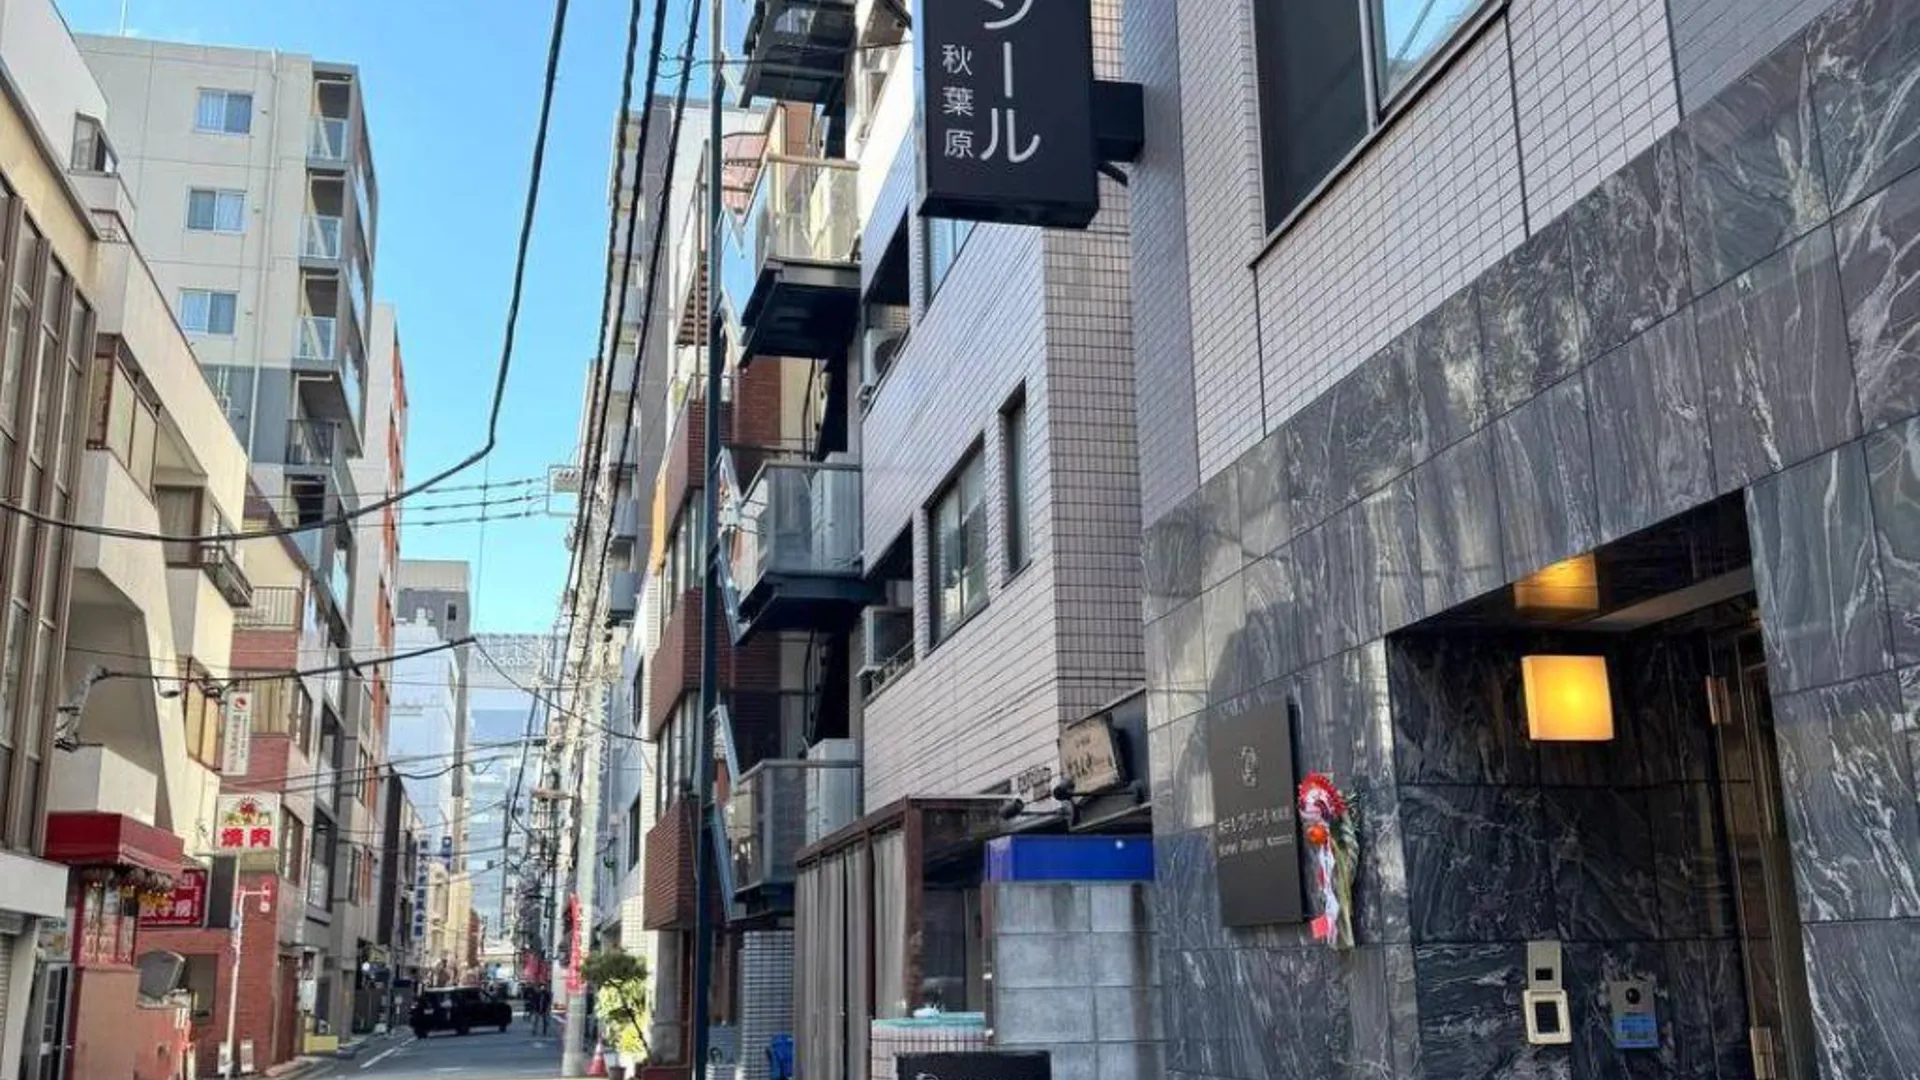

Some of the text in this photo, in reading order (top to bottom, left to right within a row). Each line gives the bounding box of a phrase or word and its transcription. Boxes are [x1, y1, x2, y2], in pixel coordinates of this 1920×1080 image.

[941, 43, 975, 159] 秋葉原
[221, 827, 271, 848] 焼肉
